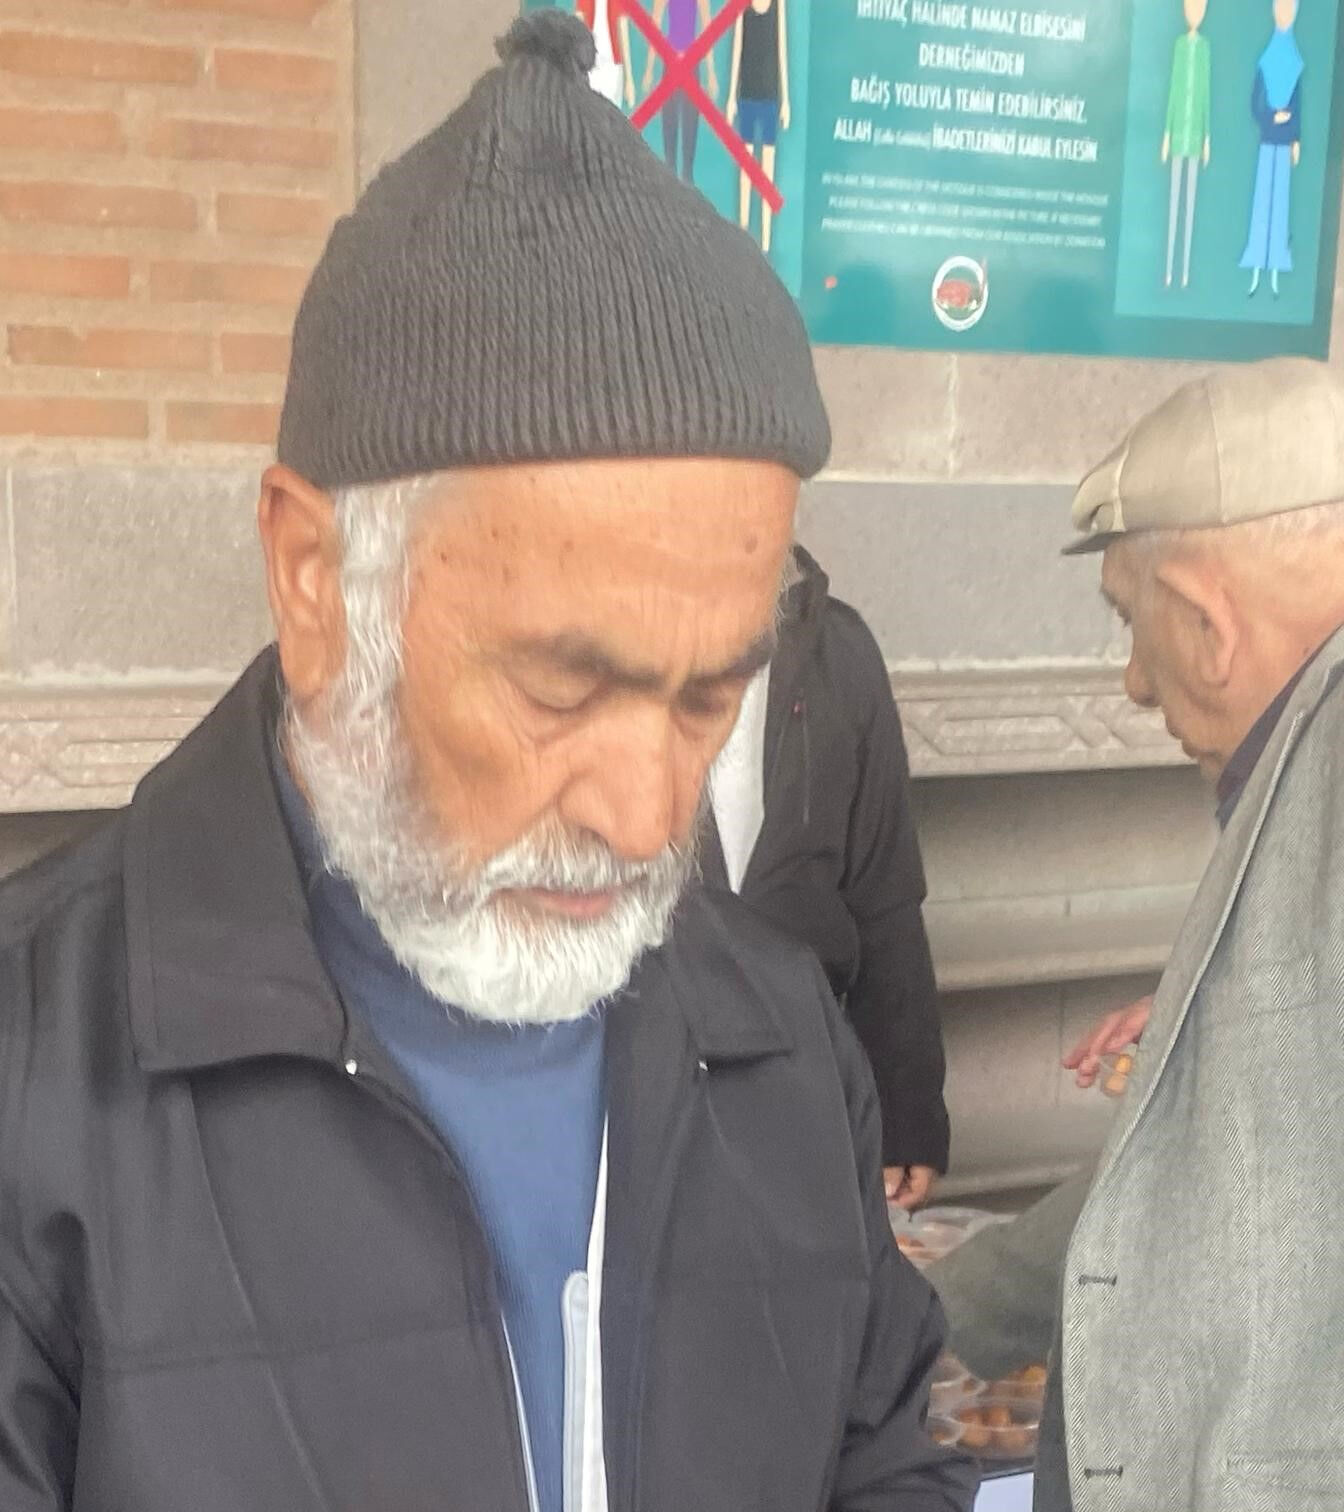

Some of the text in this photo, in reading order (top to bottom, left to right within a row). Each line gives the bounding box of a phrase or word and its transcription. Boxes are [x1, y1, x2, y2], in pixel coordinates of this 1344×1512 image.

[971, 6, 1017, 34] NAMAZ
[919, 42, 1024, 76] DERNEĞİMİZDEN
[850, 73, 890, 110] BAĞIŞ
[895, 82, 951, 110] YOLUYLA
[956, 86, 994, 113] TEMİN
[834, 117, 872, 142] ALLAH
